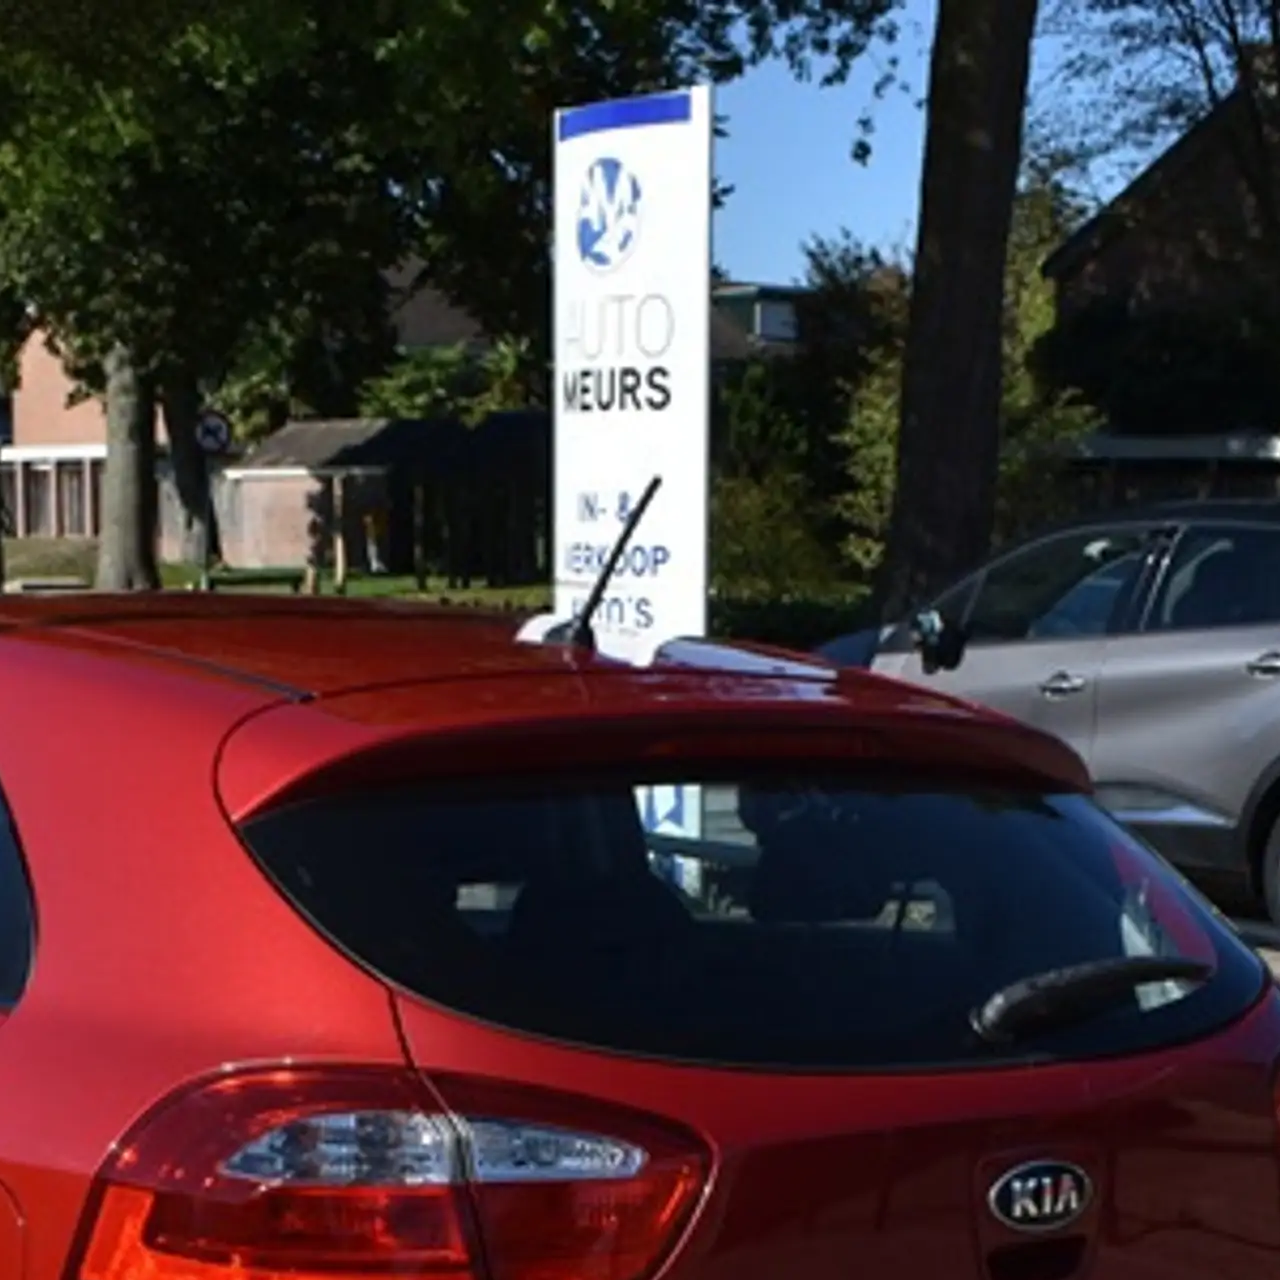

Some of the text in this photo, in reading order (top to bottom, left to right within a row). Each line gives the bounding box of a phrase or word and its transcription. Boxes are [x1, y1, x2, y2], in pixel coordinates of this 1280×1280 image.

[564, 293, 676, 362] AUTO
[563, 365, 672, 413] MEURS
[1012, 1174, 1078, 1217] KIA
